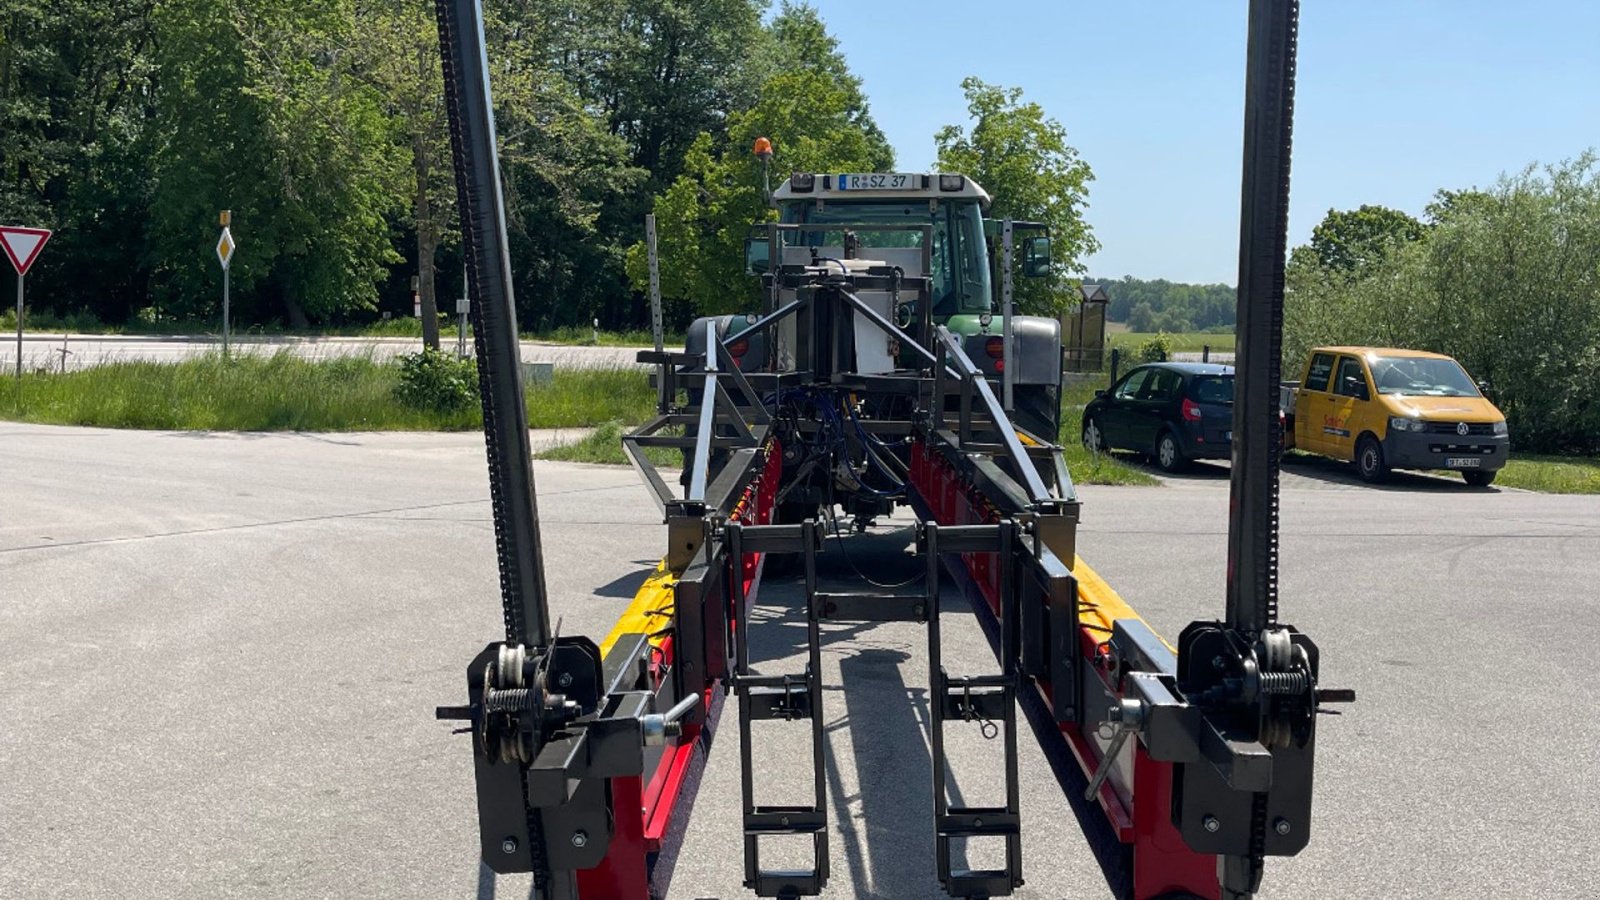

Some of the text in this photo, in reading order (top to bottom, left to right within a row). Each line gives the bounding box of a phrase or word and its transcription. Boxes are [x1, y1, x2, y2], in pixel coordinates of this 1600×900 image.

[852, 175, 906, 188] R SZ 37
